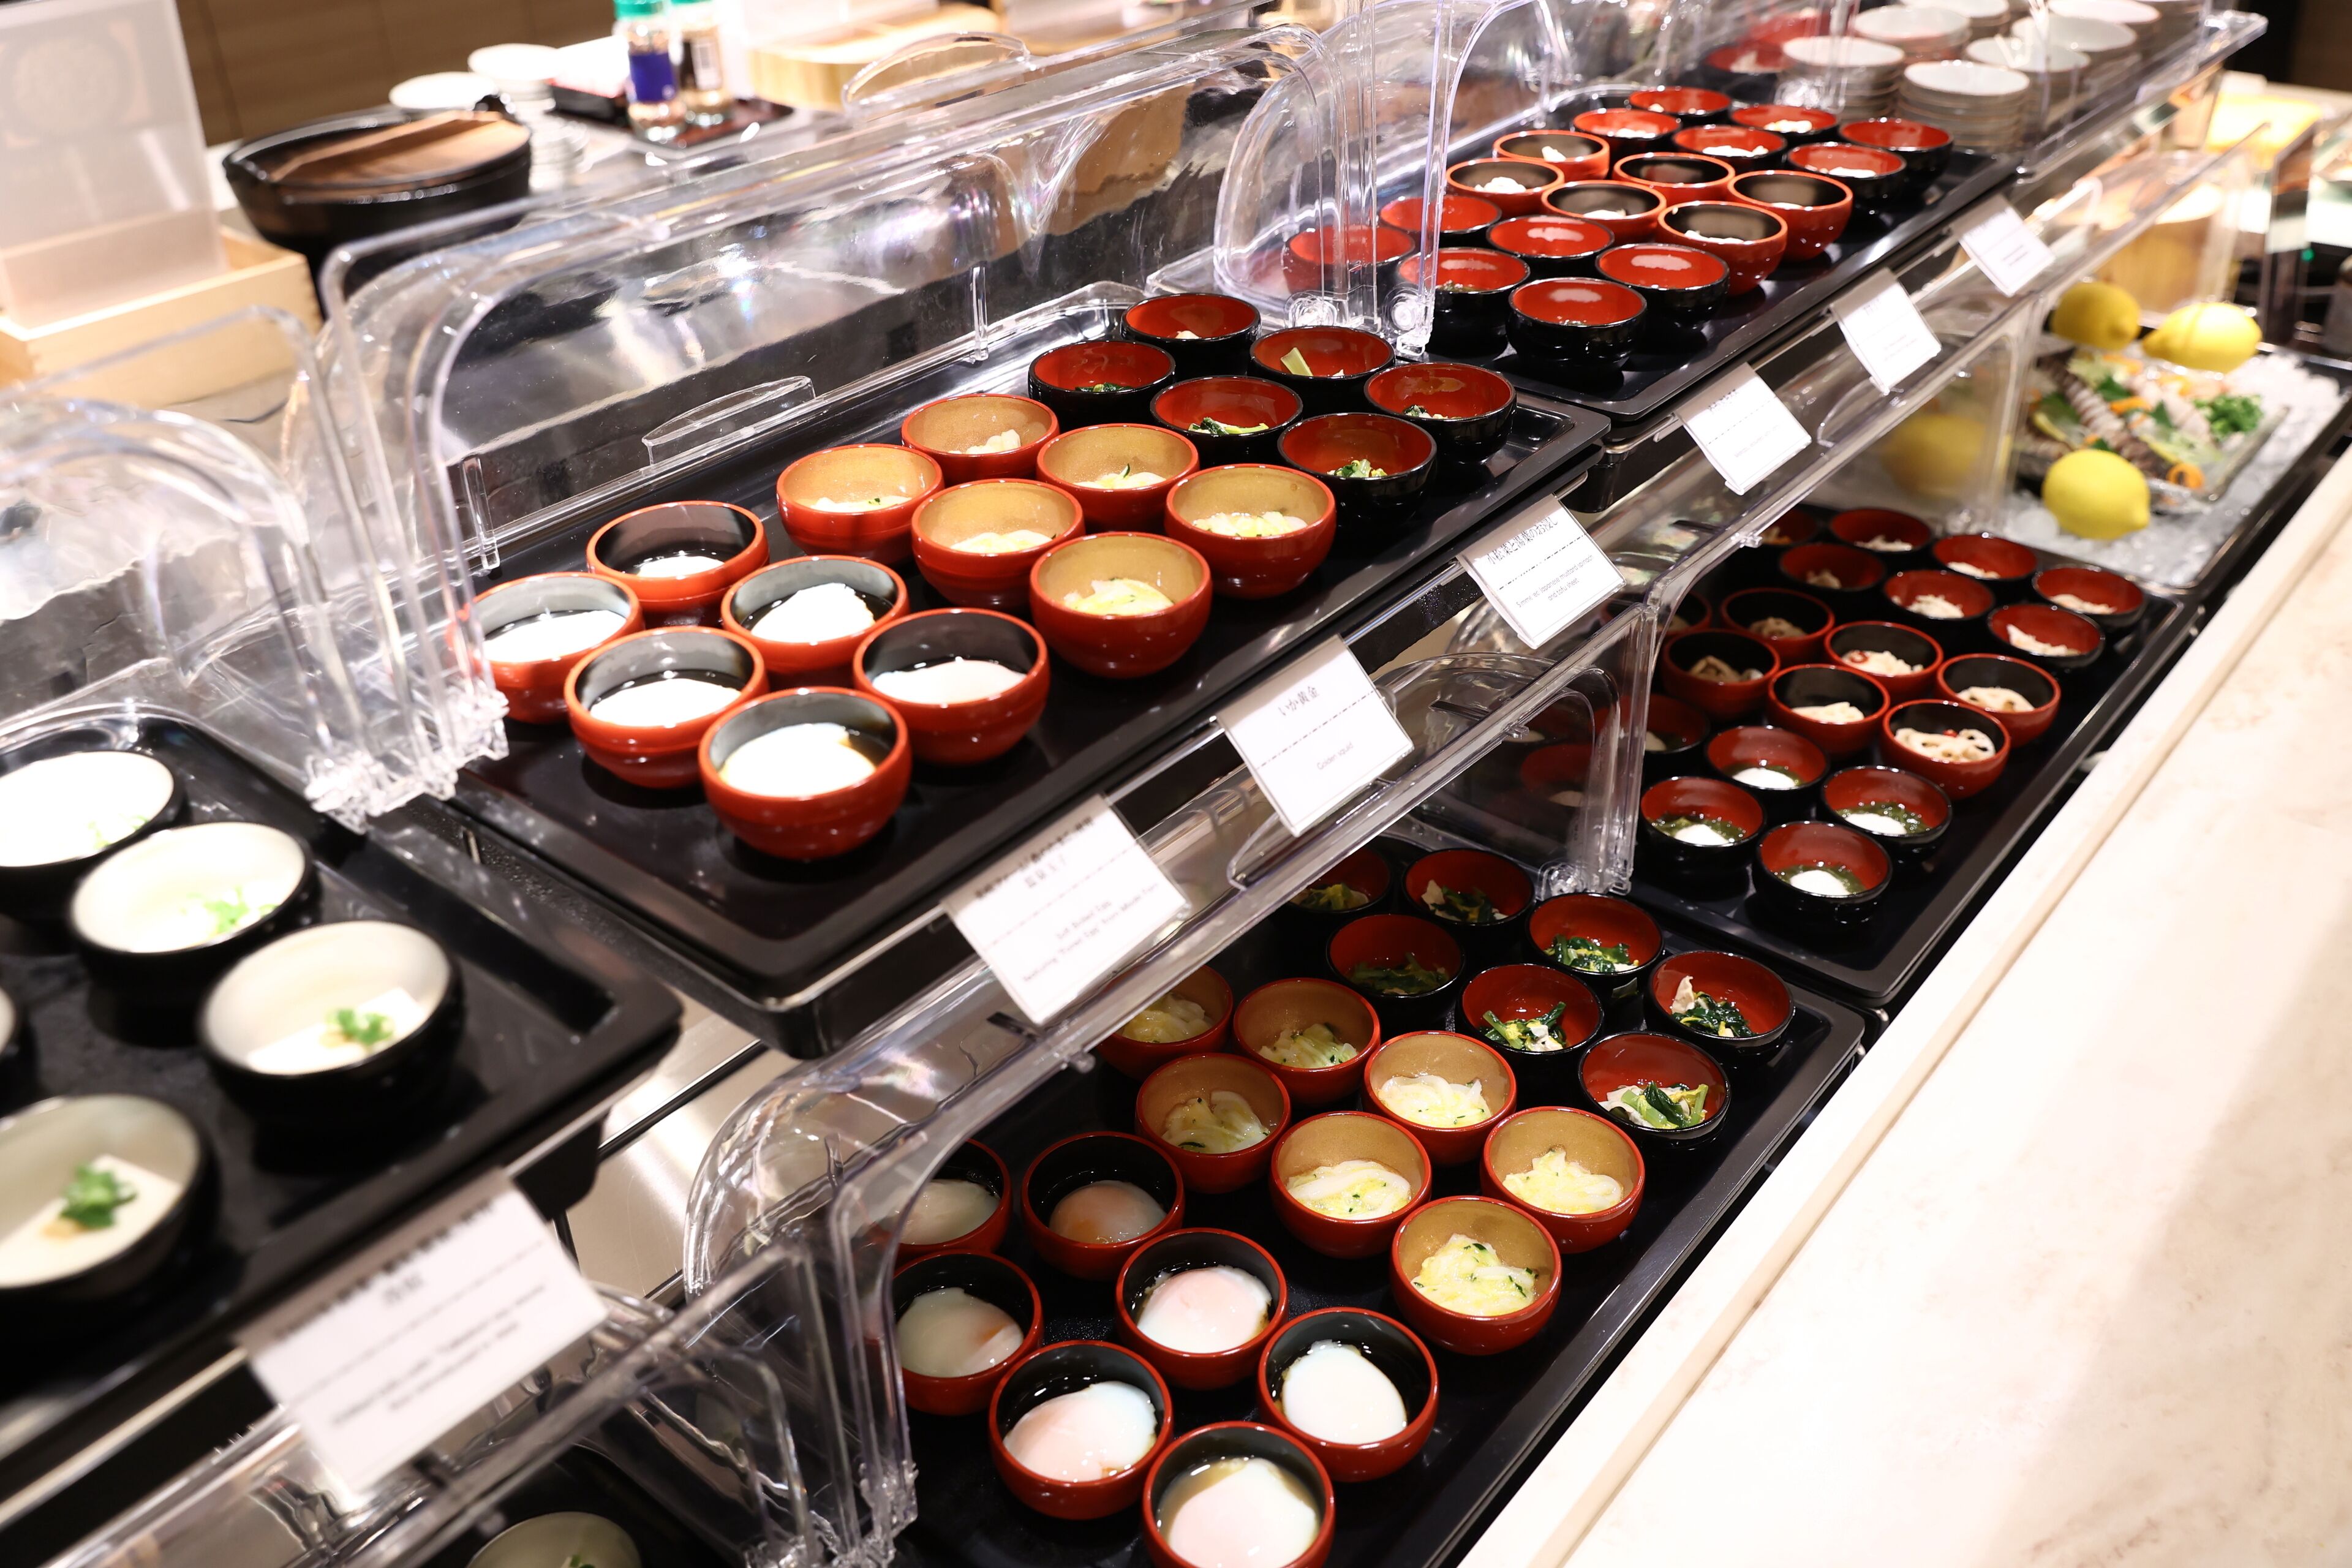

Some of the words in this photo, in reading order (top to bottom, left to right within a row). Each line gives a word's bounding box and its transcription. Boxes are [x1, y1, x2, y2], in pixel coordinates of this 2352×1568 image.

[1487, 515, 1558, 564] 小松菜と湯葉のお浸し
[1516, 590, 1540, 608] Simmeed
[1559, 564, 1578, 579] mustard
[1547, 591, 1558, 601] and
[1556, 585, 1568, 595] tofu
[1278, 685, 1319, 716] いか黄金
[1316, 754, 1336, 771] Golden
